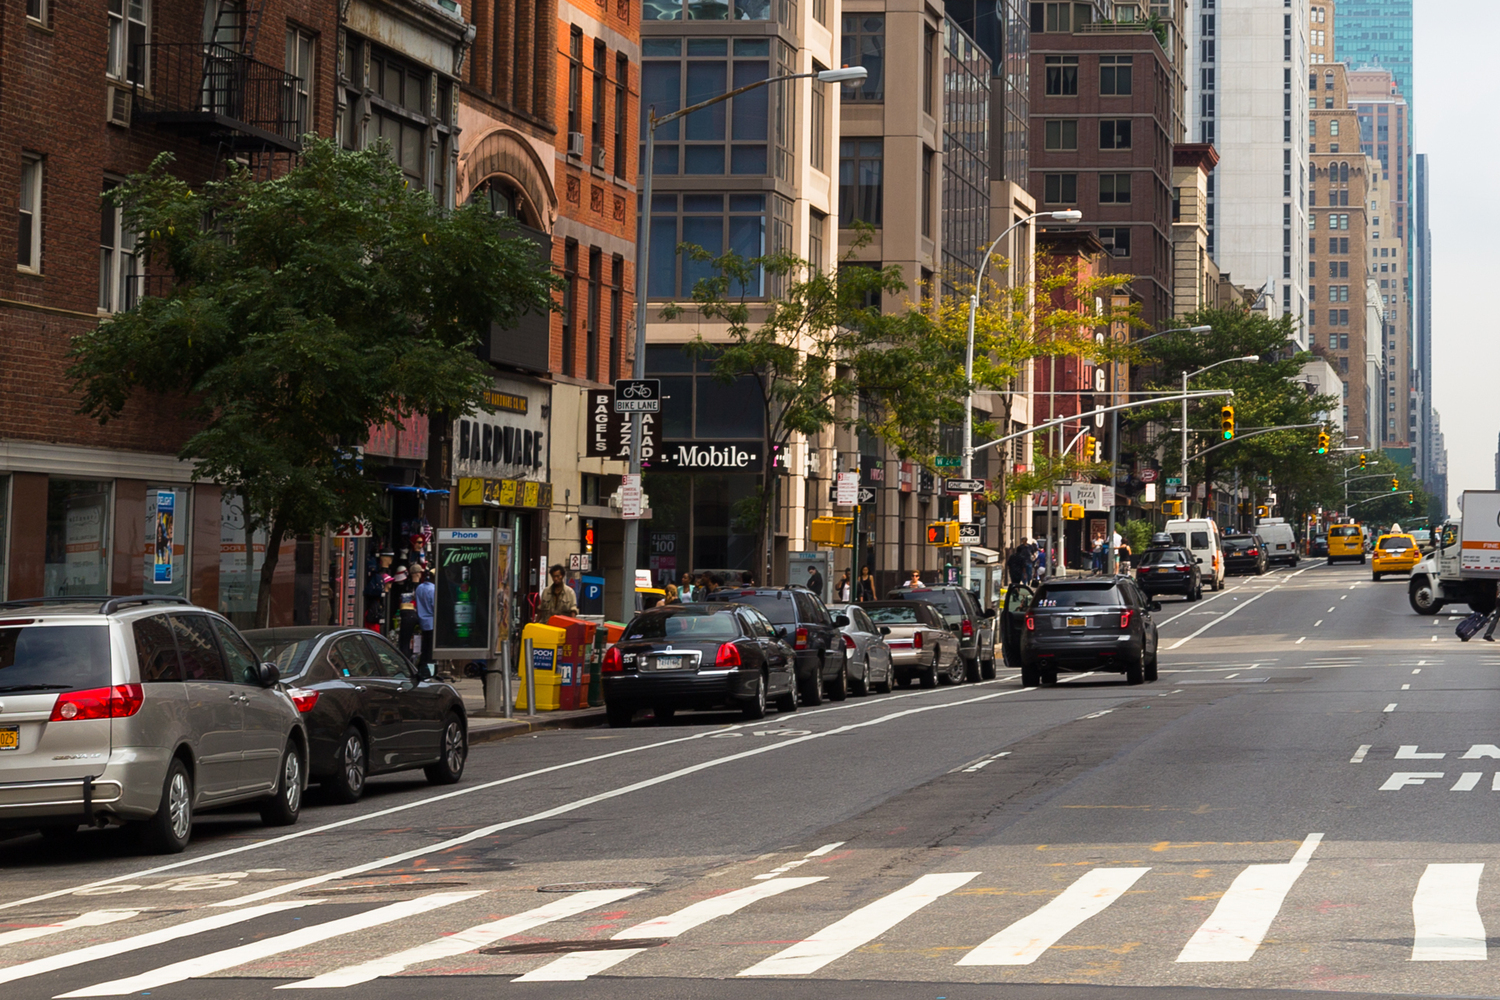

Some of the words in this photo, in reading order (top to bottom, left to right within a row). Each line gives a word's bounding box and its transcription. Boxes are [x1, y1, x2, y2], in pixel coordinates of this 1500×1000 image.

[617, 401, 635, 410] BIKE
[637, 401, 657, 410] LANE
[594, 395, 609, 452] BAGELS
[460, 419, 544, 470] HARDWARE
[1077, 491, 1096, 500] PIZZA
[452, 531, 478, 539] Phone
[652, 541, 674, 552] $100
